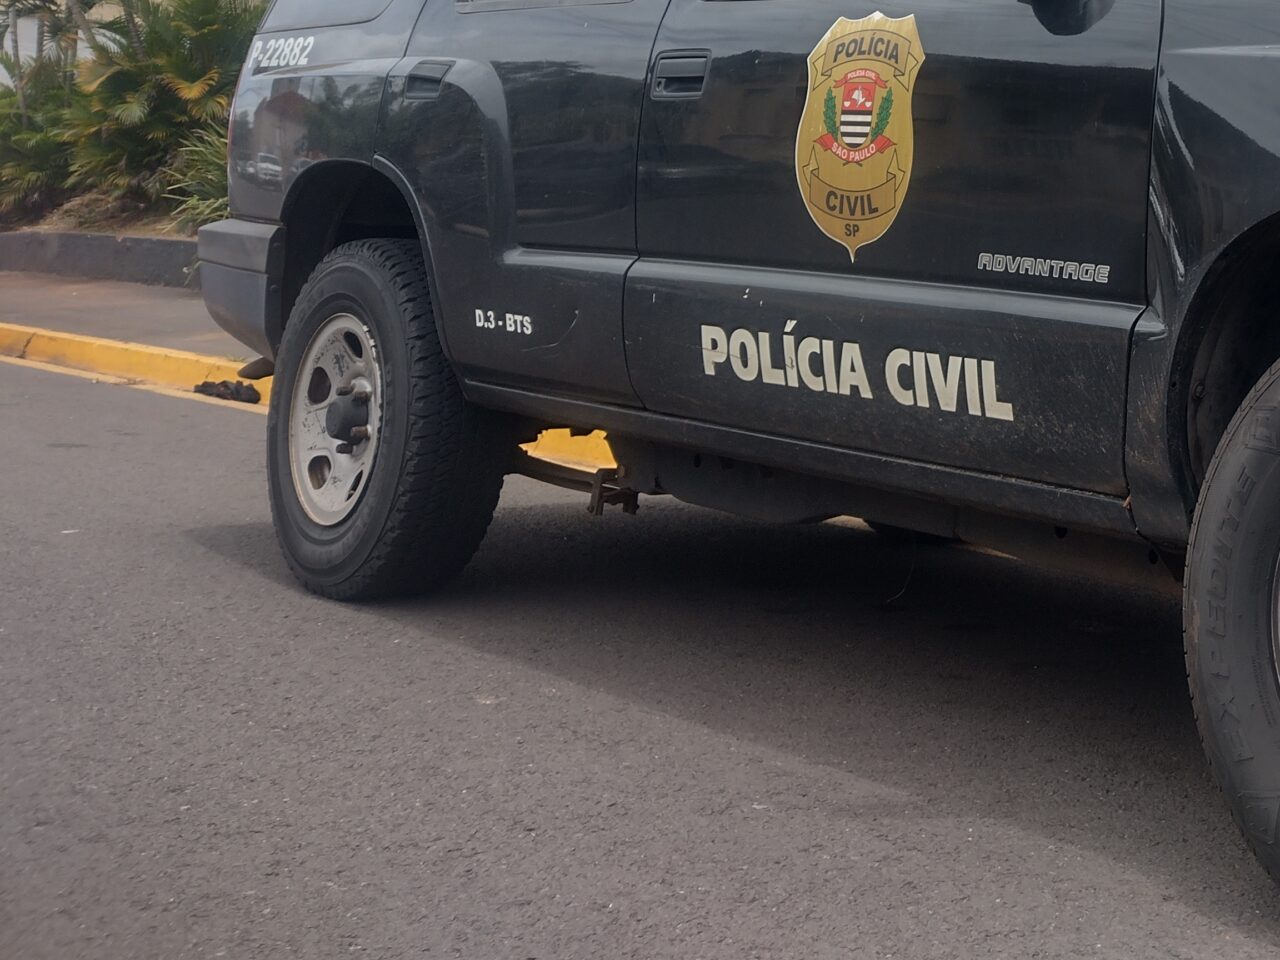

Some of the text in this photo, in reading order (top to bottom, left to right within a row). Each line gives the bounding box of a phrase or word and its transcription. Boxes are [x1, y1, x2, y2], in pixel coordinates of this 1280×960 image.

[247, 35, 315, 69] P-22882
[832, 31, 899, 64] POLÍCIA
[848, 143, 876, 161] PAULO
[825, 190, 879, 217] CIVIL
[844, 223, 860, 238] SP
[977, 252, 1111, 284] ADVANTAGE
[475, 308, 496, 329] D.3
[506, 313, 533, 335] BTS
[701, 319, 1014, 422] POLÍCIA CIVIL
